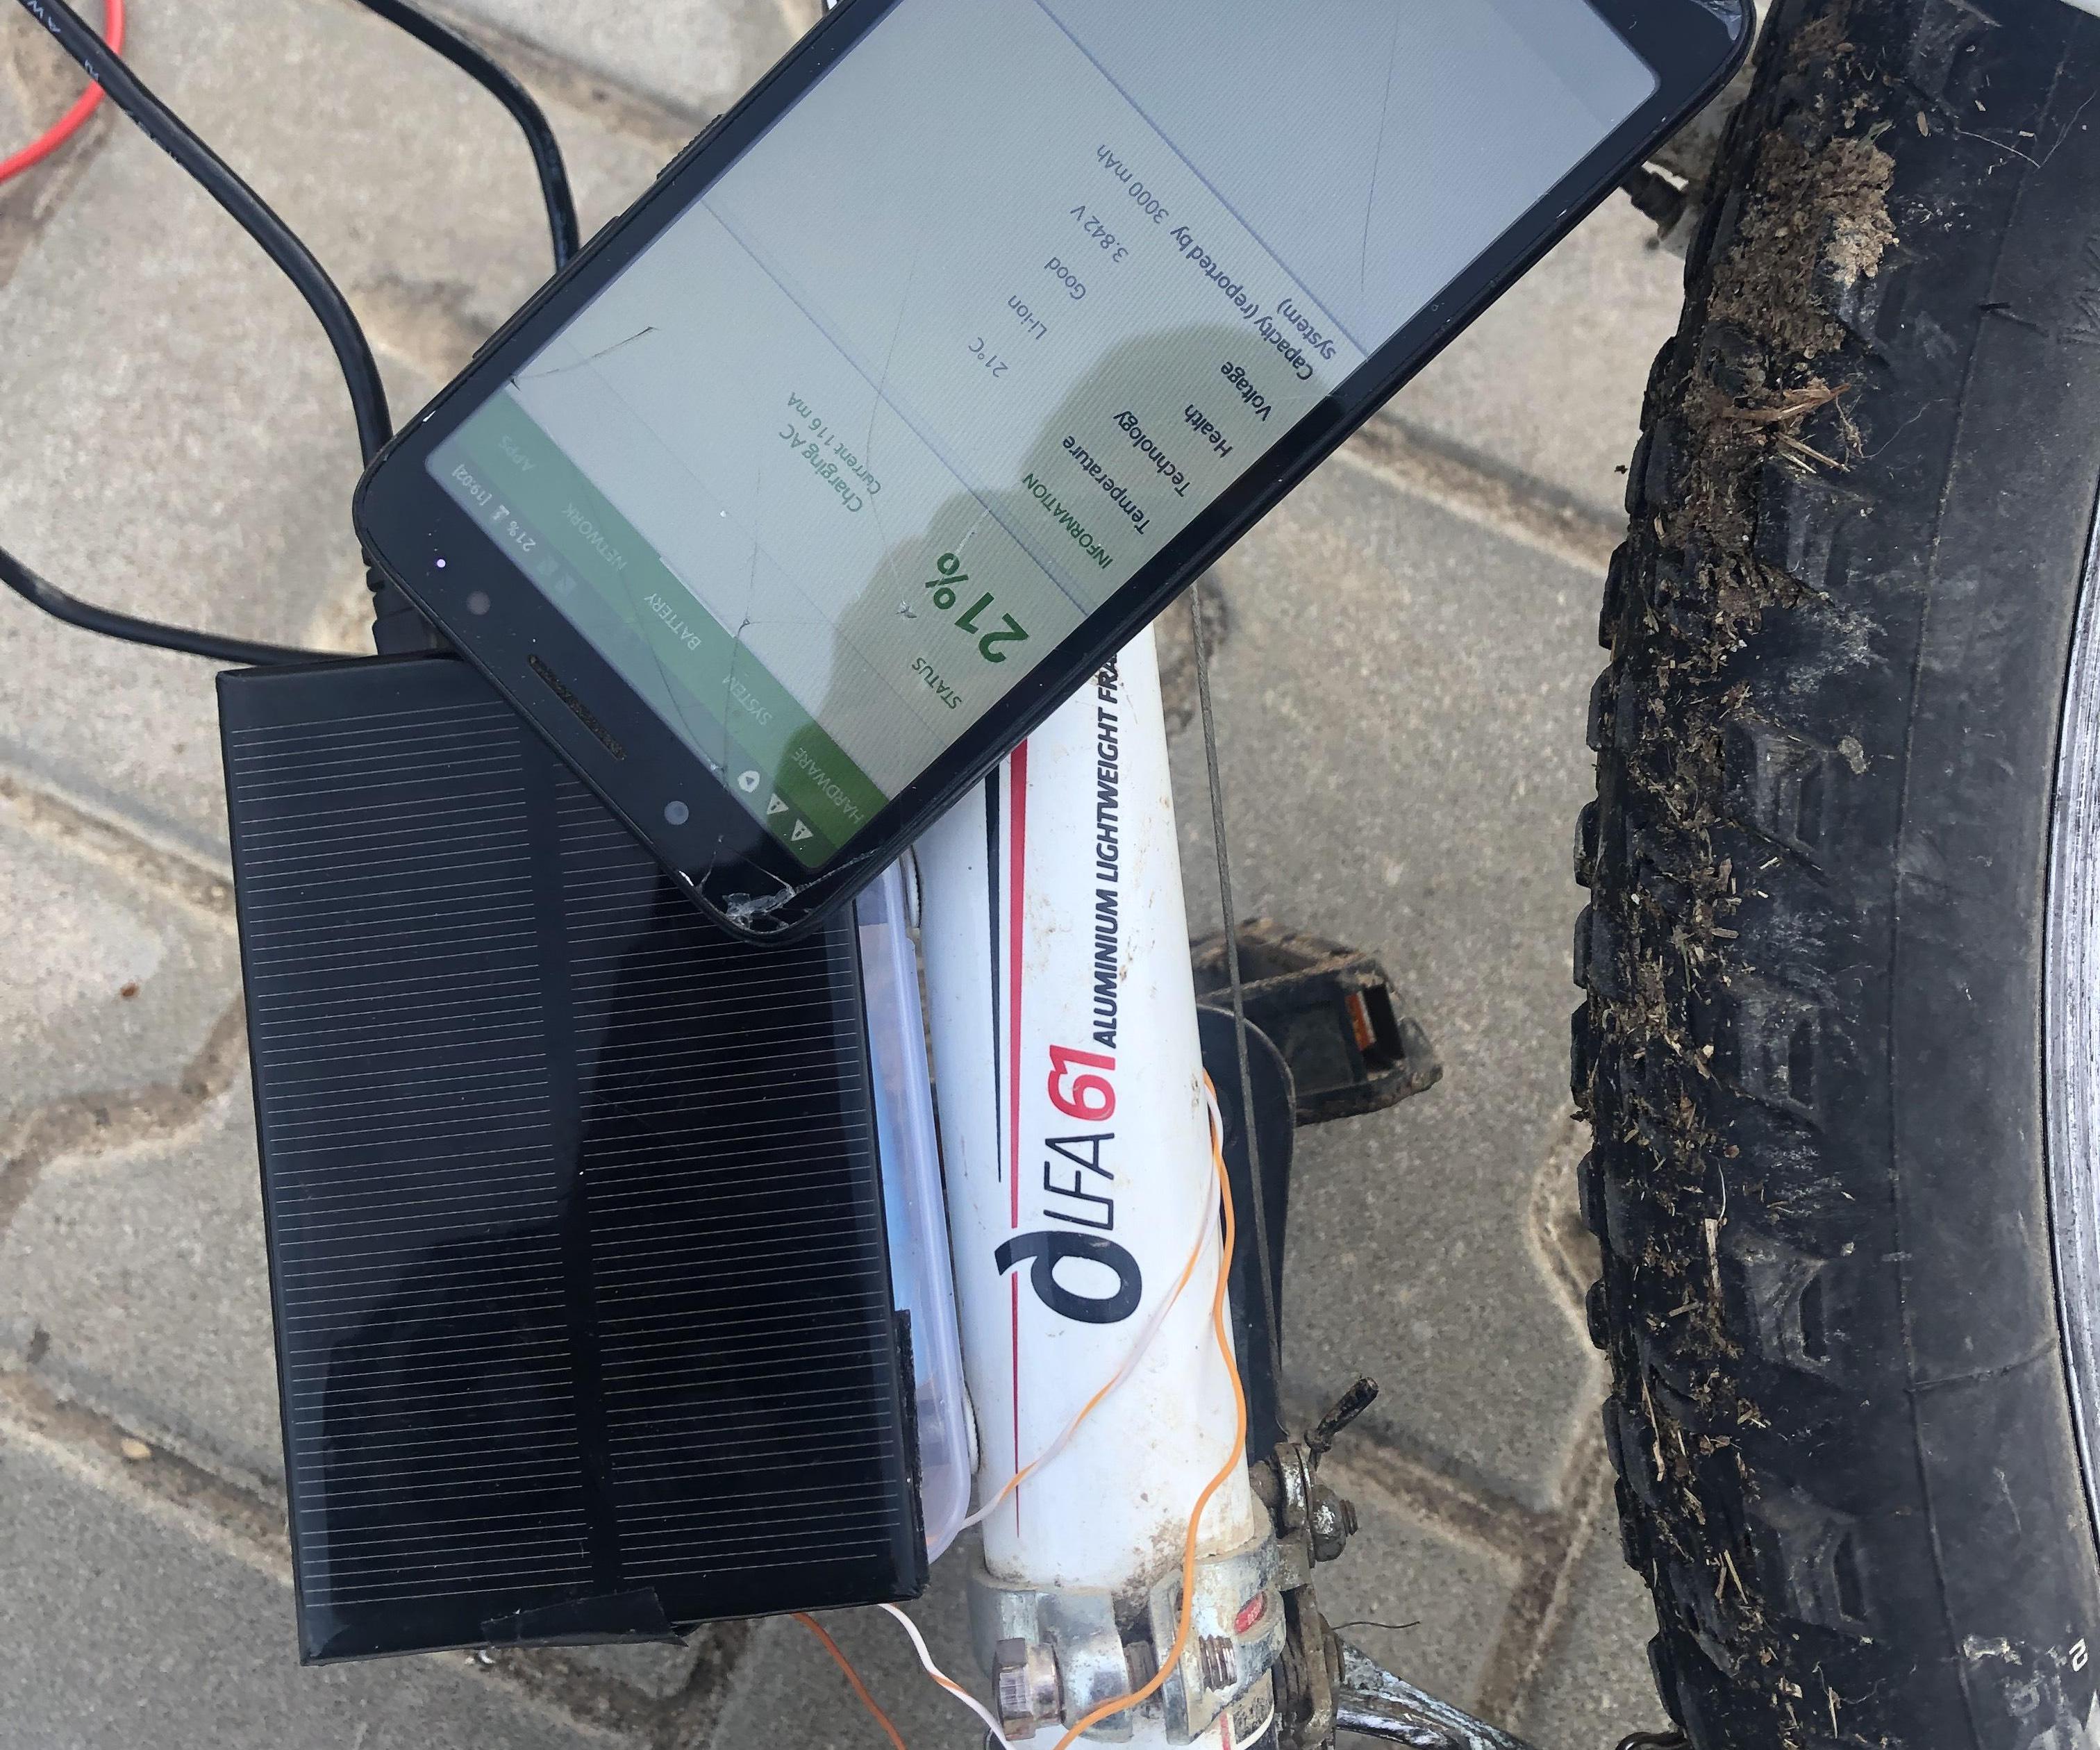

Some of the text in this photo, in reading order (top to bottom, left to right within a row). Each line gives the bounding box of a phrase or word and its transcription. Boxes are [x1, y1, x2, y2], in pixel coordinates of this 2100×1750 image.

[1097, 144, 1169, 224] 3000 mAh
[1070, 206, 1128, 262] 3.842 V
[1044, 257, 1086, 300] Good
[1170, 226, 1313, 380] Capacity (reported by
[1008, 295, 1047, 340] Li-ion
[1277, 299, 1336, 360] system)
[968, 337, 1008, 378] 21°C
[1221, 362, 1272, 422] Voltage
[499, 435, 535, 471] APPS
[788, 392, 881, 496] Current 116 mA
[1113, 411, 1190, 497] Technology
[1185, 404, 1233, 458] Health
[779, 424, 862, 512] Charging AC
[1062, 436, 1149, 535] Temperature
[507, 521, 536, 552] 21%
[562, 503, 627, 570] NETWORK
[1022, 473, 1112, 569] INFORMATION
[644, 593, 701, 650] BATTERY
[926, 553, 1029, 663] 21%
[722, 669, 772, 725] SYSTEM
[912, 658, 962, 709] STATUS
[792, 747, 865, 824] HARDWARE
[1095, 707, 1119, 883] LIGHTWEIGHT
[1092, 888, 1118, 1049] ALUMINIUM
[1047, 1044, 1116, 1122] 61
